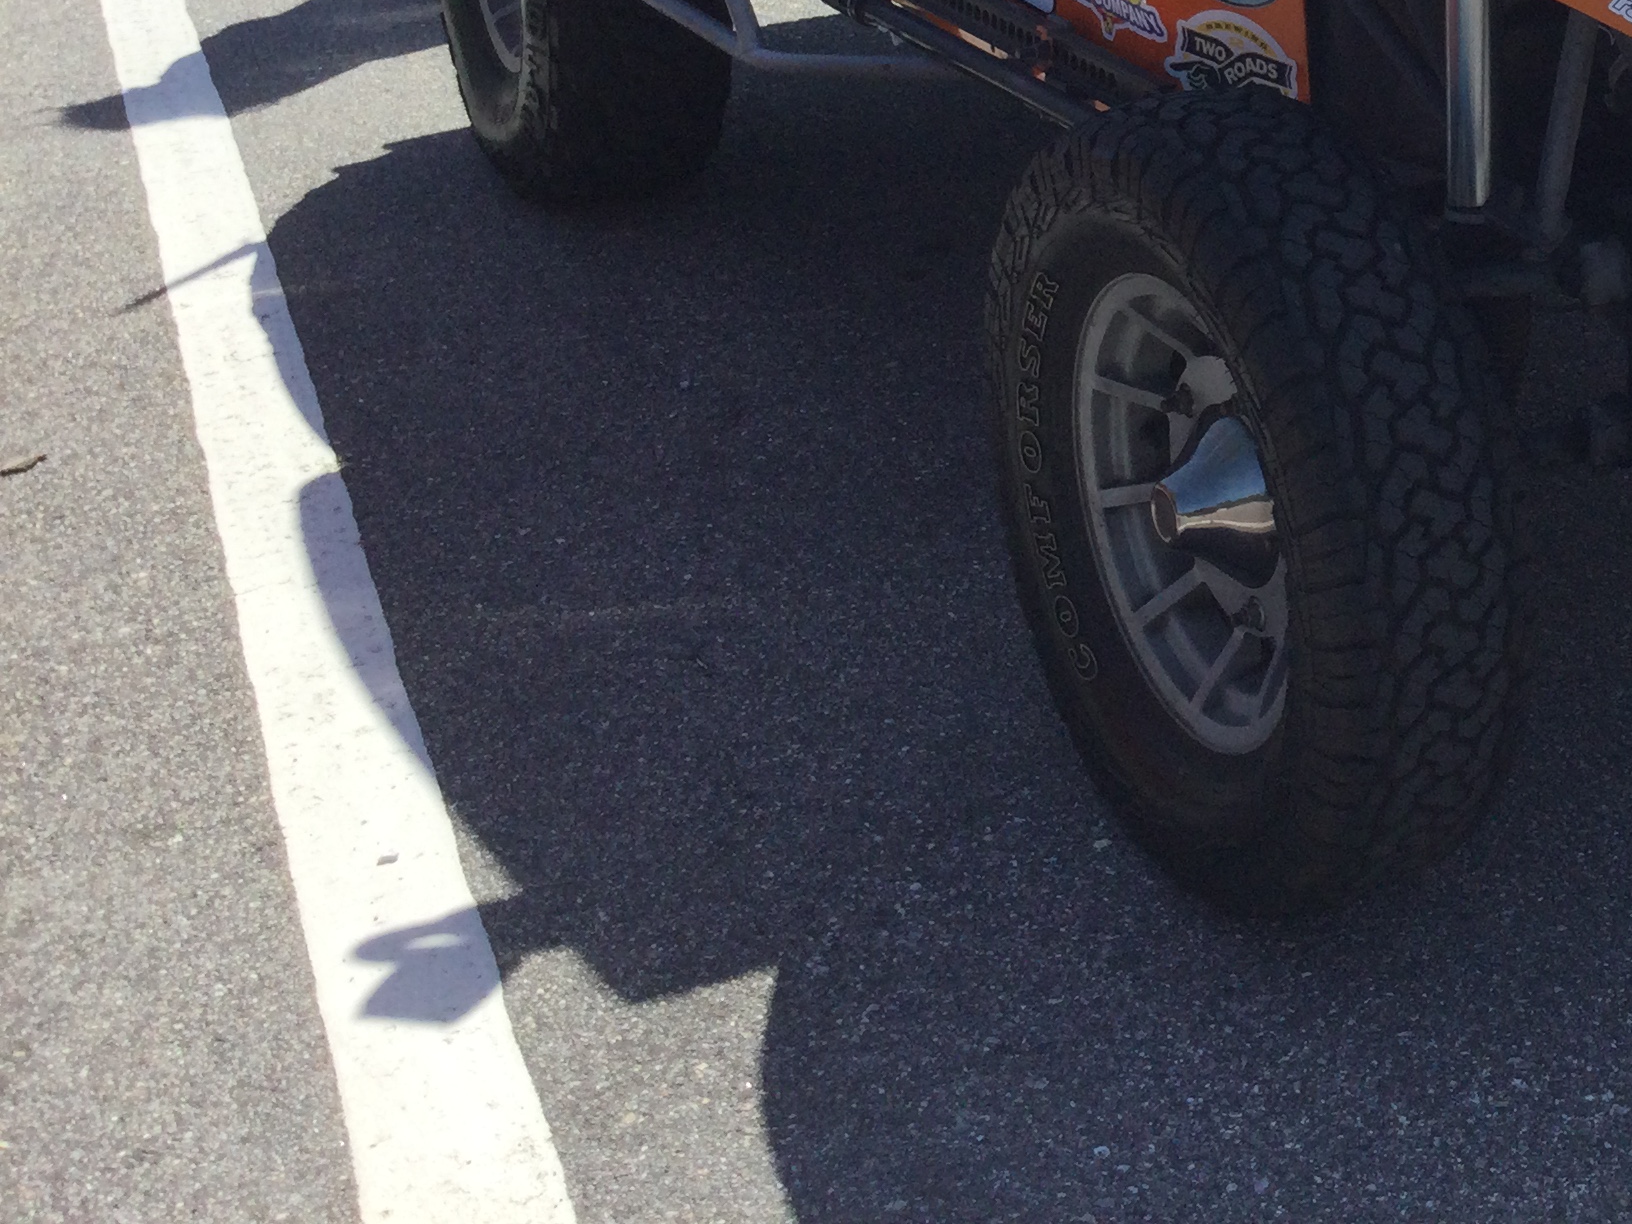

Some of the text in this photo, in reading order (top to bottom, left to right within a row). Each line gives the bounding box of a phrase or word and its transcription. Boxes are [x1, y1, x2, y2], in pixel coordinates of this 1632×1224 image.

[1194, 37, 1227, 62] TWO
[1223, 57, 1279, 85] ROADS
[1016, 272, 1099, 682] COMFORSER
